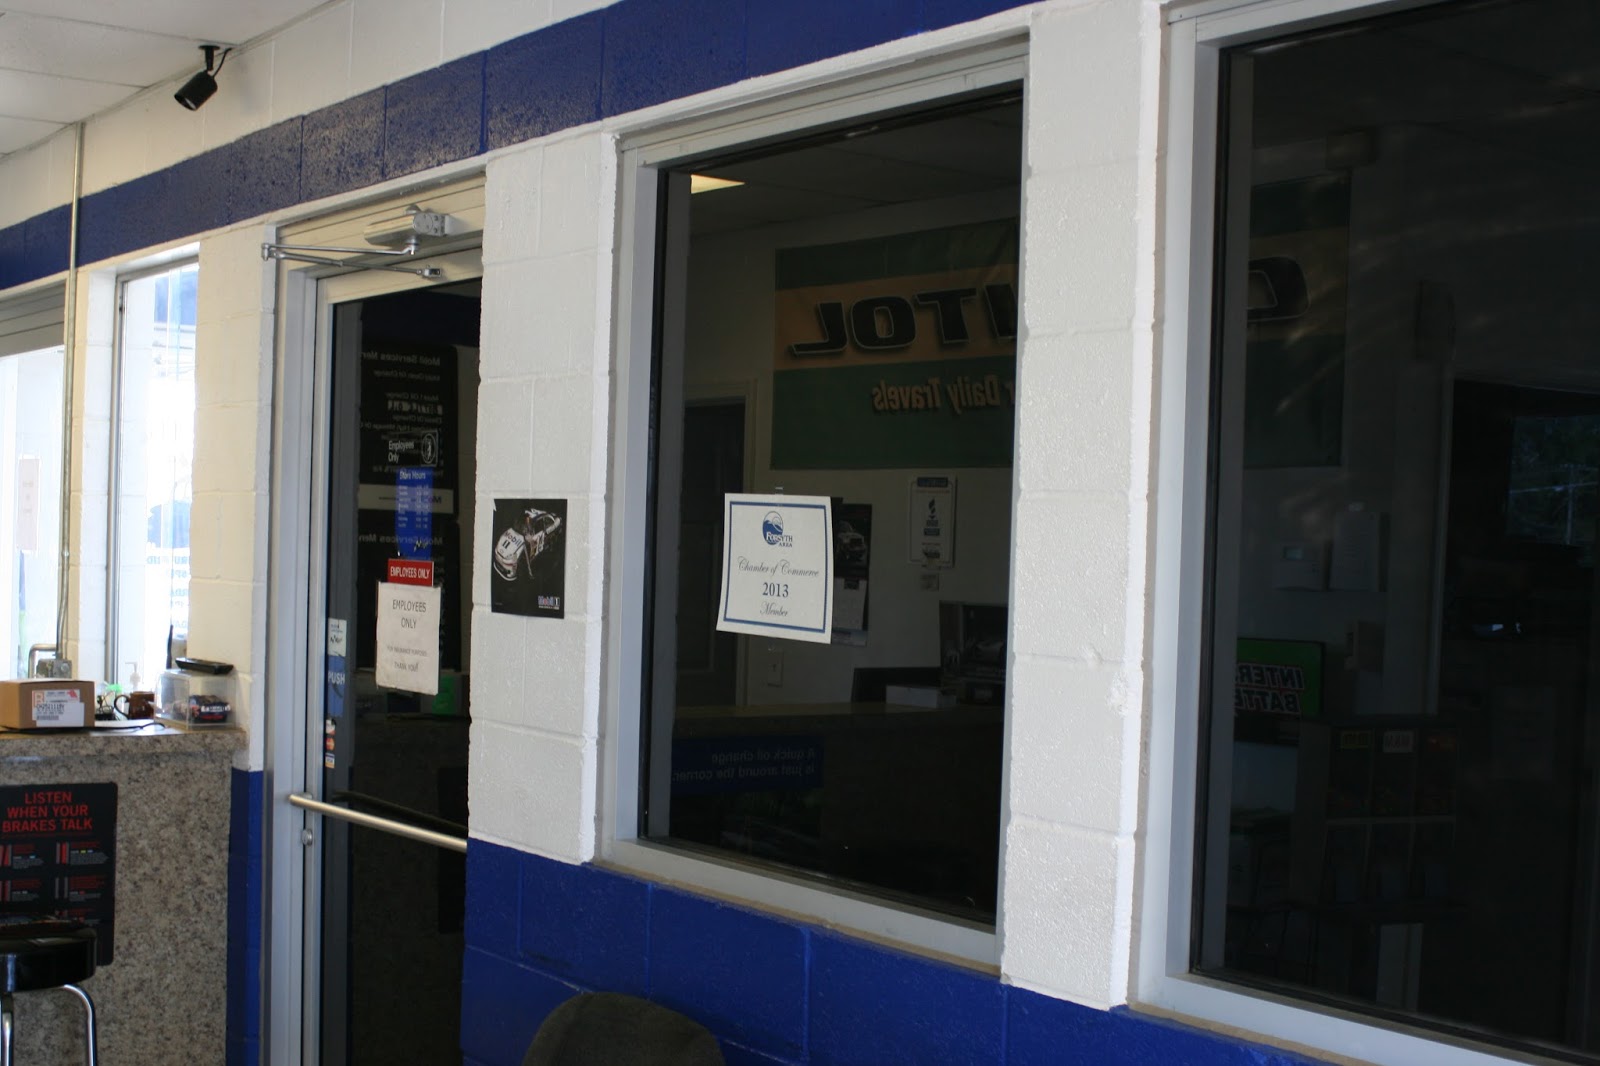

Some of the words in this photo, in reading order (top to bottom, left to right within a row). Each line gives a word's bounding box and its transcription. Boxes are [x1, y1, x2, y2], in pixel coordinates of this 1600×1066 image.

[388, 440, 415, 452] Employees
[387, 451, 400, 464] Only
[765, 531, 793, 543] FORSYTH
[390, 566, 417, 578] EMPLOYEES
[418, 568, 431, 579] ONLY
[738, 556, 769, 573] Chamber
[770, 565, 778, 578] of
[779, 559, 819, 578] Commerce
[762, 582, 789, 598] 2013
[392, 599, 427, 613] EMPLOYEES
[760, 601, 789, 617] Member
[401, 617, 417, 629] ONLY
[328, 671, 346, 685] PUSH
[24, 790, 73, 805] LISTEN
[7, 805, 49, 819] WHEN
[52, 804, 89, 817] YOUR
[2, 819, 57, 833] BRAKES
[60, 817, 93, 831] TALK
